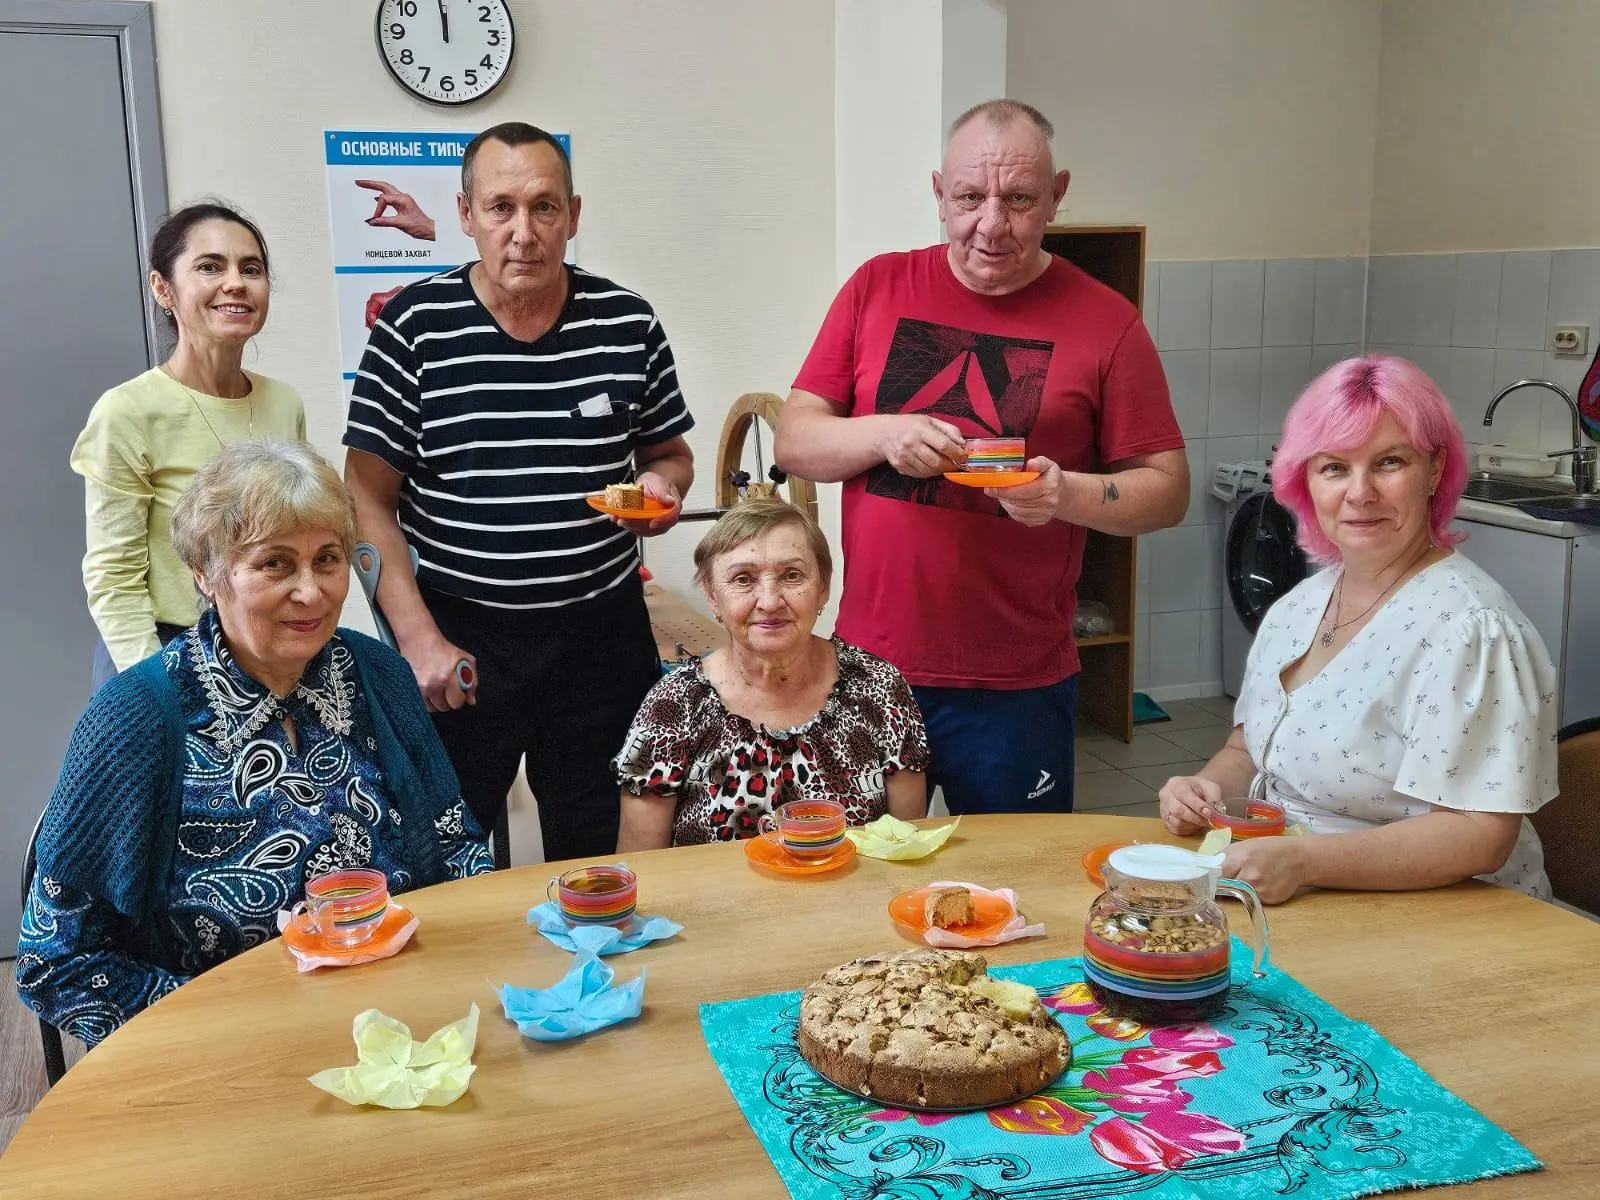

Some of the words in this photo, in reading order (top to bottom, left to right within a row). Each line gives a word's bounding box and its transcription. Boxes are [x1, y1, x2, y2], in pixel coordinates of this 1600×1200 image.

[396, 0, 417, 17] 10
[477, 5, 492, 23] 2
[389, 23, 406, 40] 9
[486, 29, 500, 46] 3
[399, 48, 414, 66] 8
[479, 53, 493, 70] 4
[418, 66, 431, 83] 7
[464, 69, 478, 86] 5
[439, 75, 455, 92] 6
[341, 140, 423, 157] ОСНОВНЫЕ
[365, 249, 403, 259] КОНЦЕВОЙ
[404, 250, 432, 258] ЗАХВАТ
